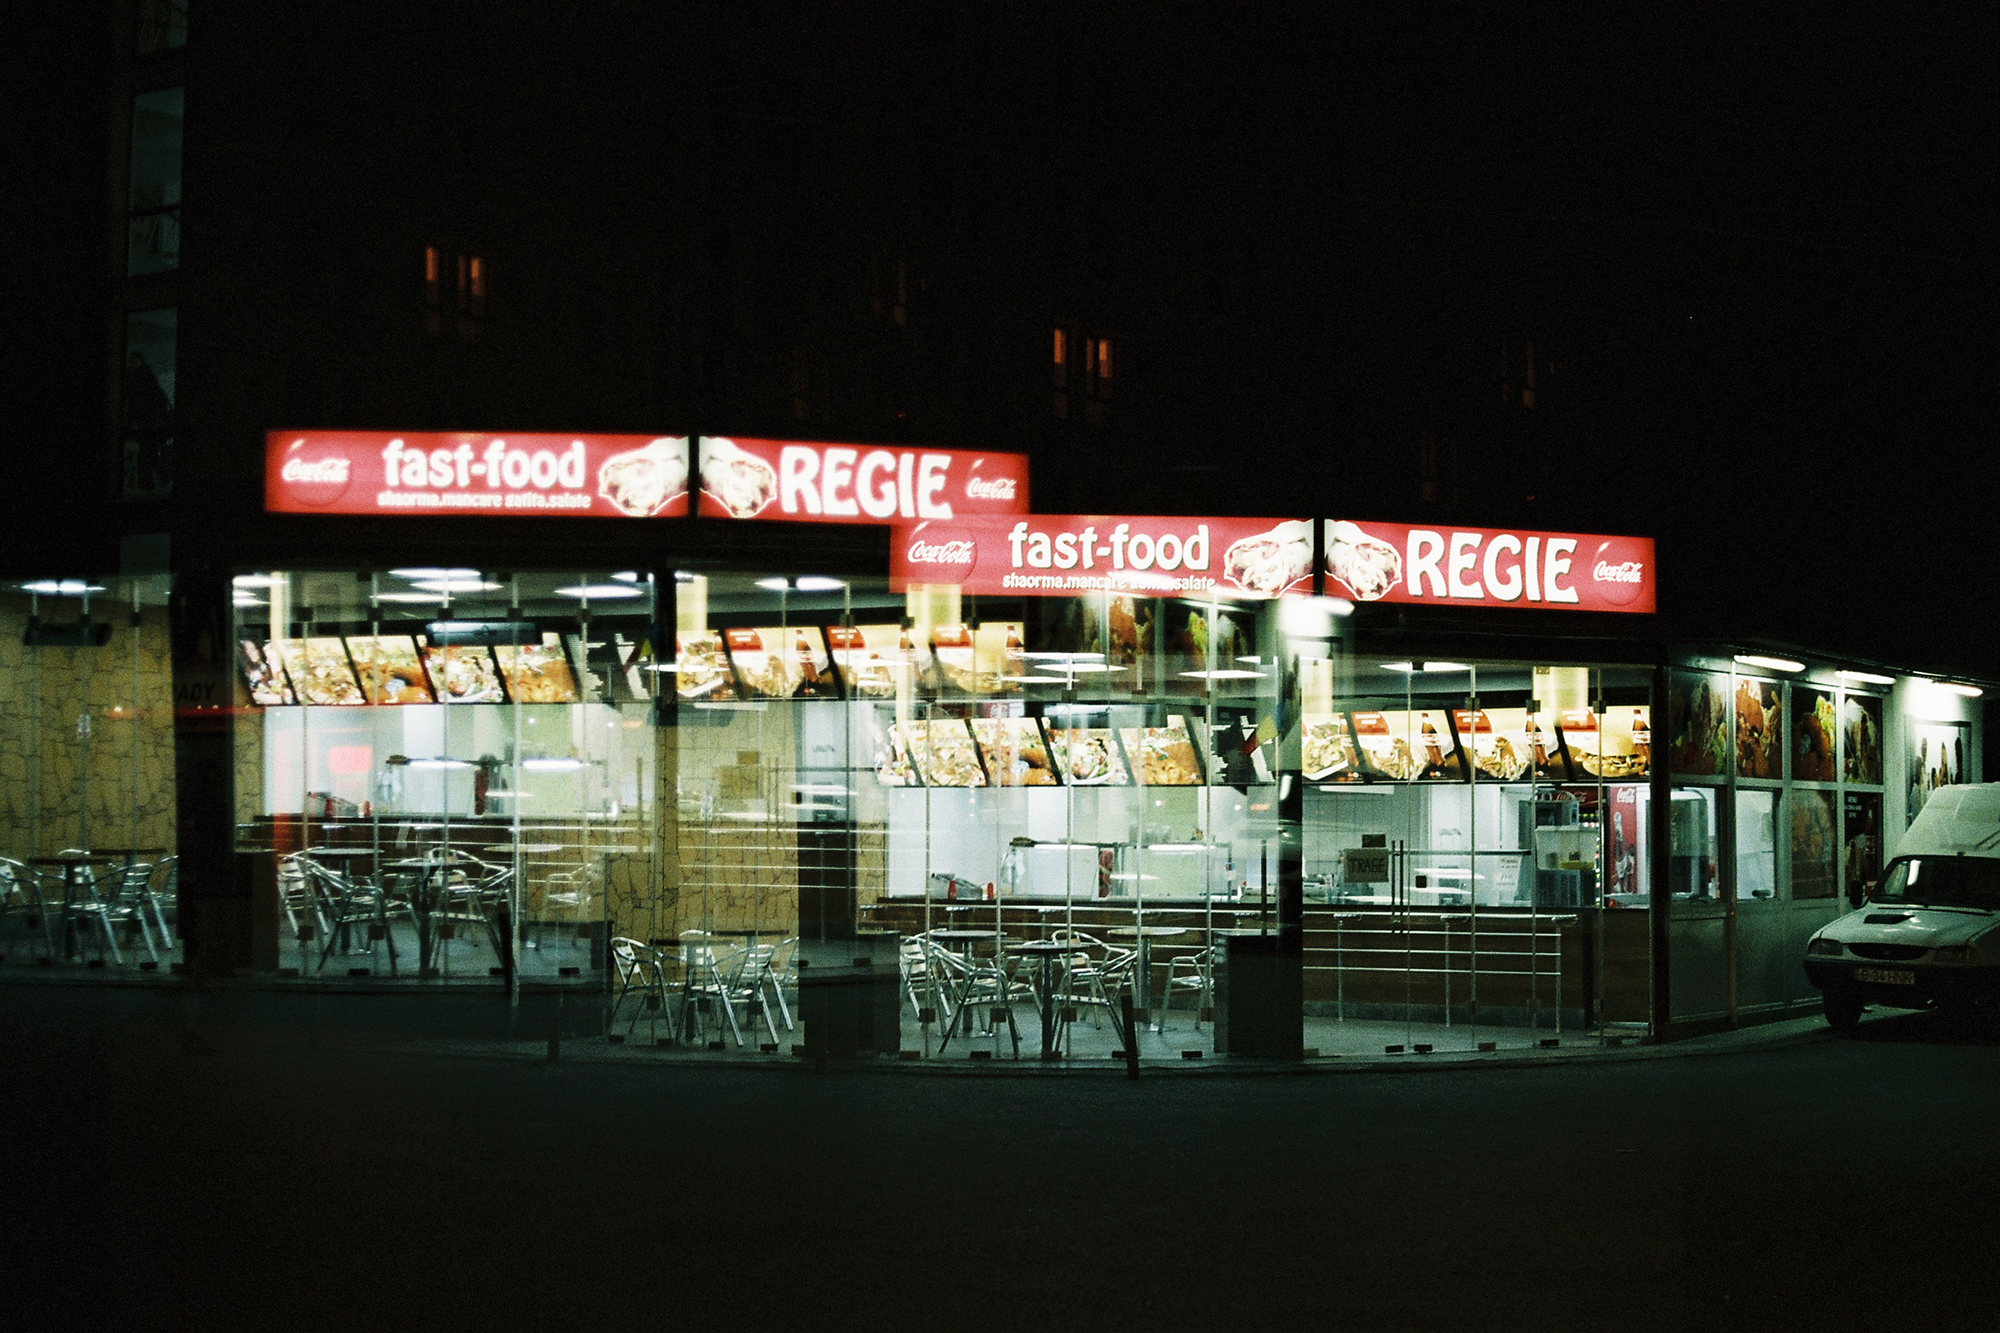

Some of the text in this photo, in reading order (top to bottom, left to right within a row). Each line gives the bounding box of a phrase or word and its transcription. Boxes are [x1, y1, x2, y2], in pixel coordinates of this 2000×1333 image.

[381, 439, 586, 488] fast-food
[780, 446, 953, 519] REGIE
[967, 478, 1017, 499] Coca-Cola
[907, 540, 975, 564] Coca-Cola
[1009, 522, 1210, 570] fast-food
[1406, 529, 1580, 604] REGIE
[1592, 560, 1643, 583] Coca-Cola
